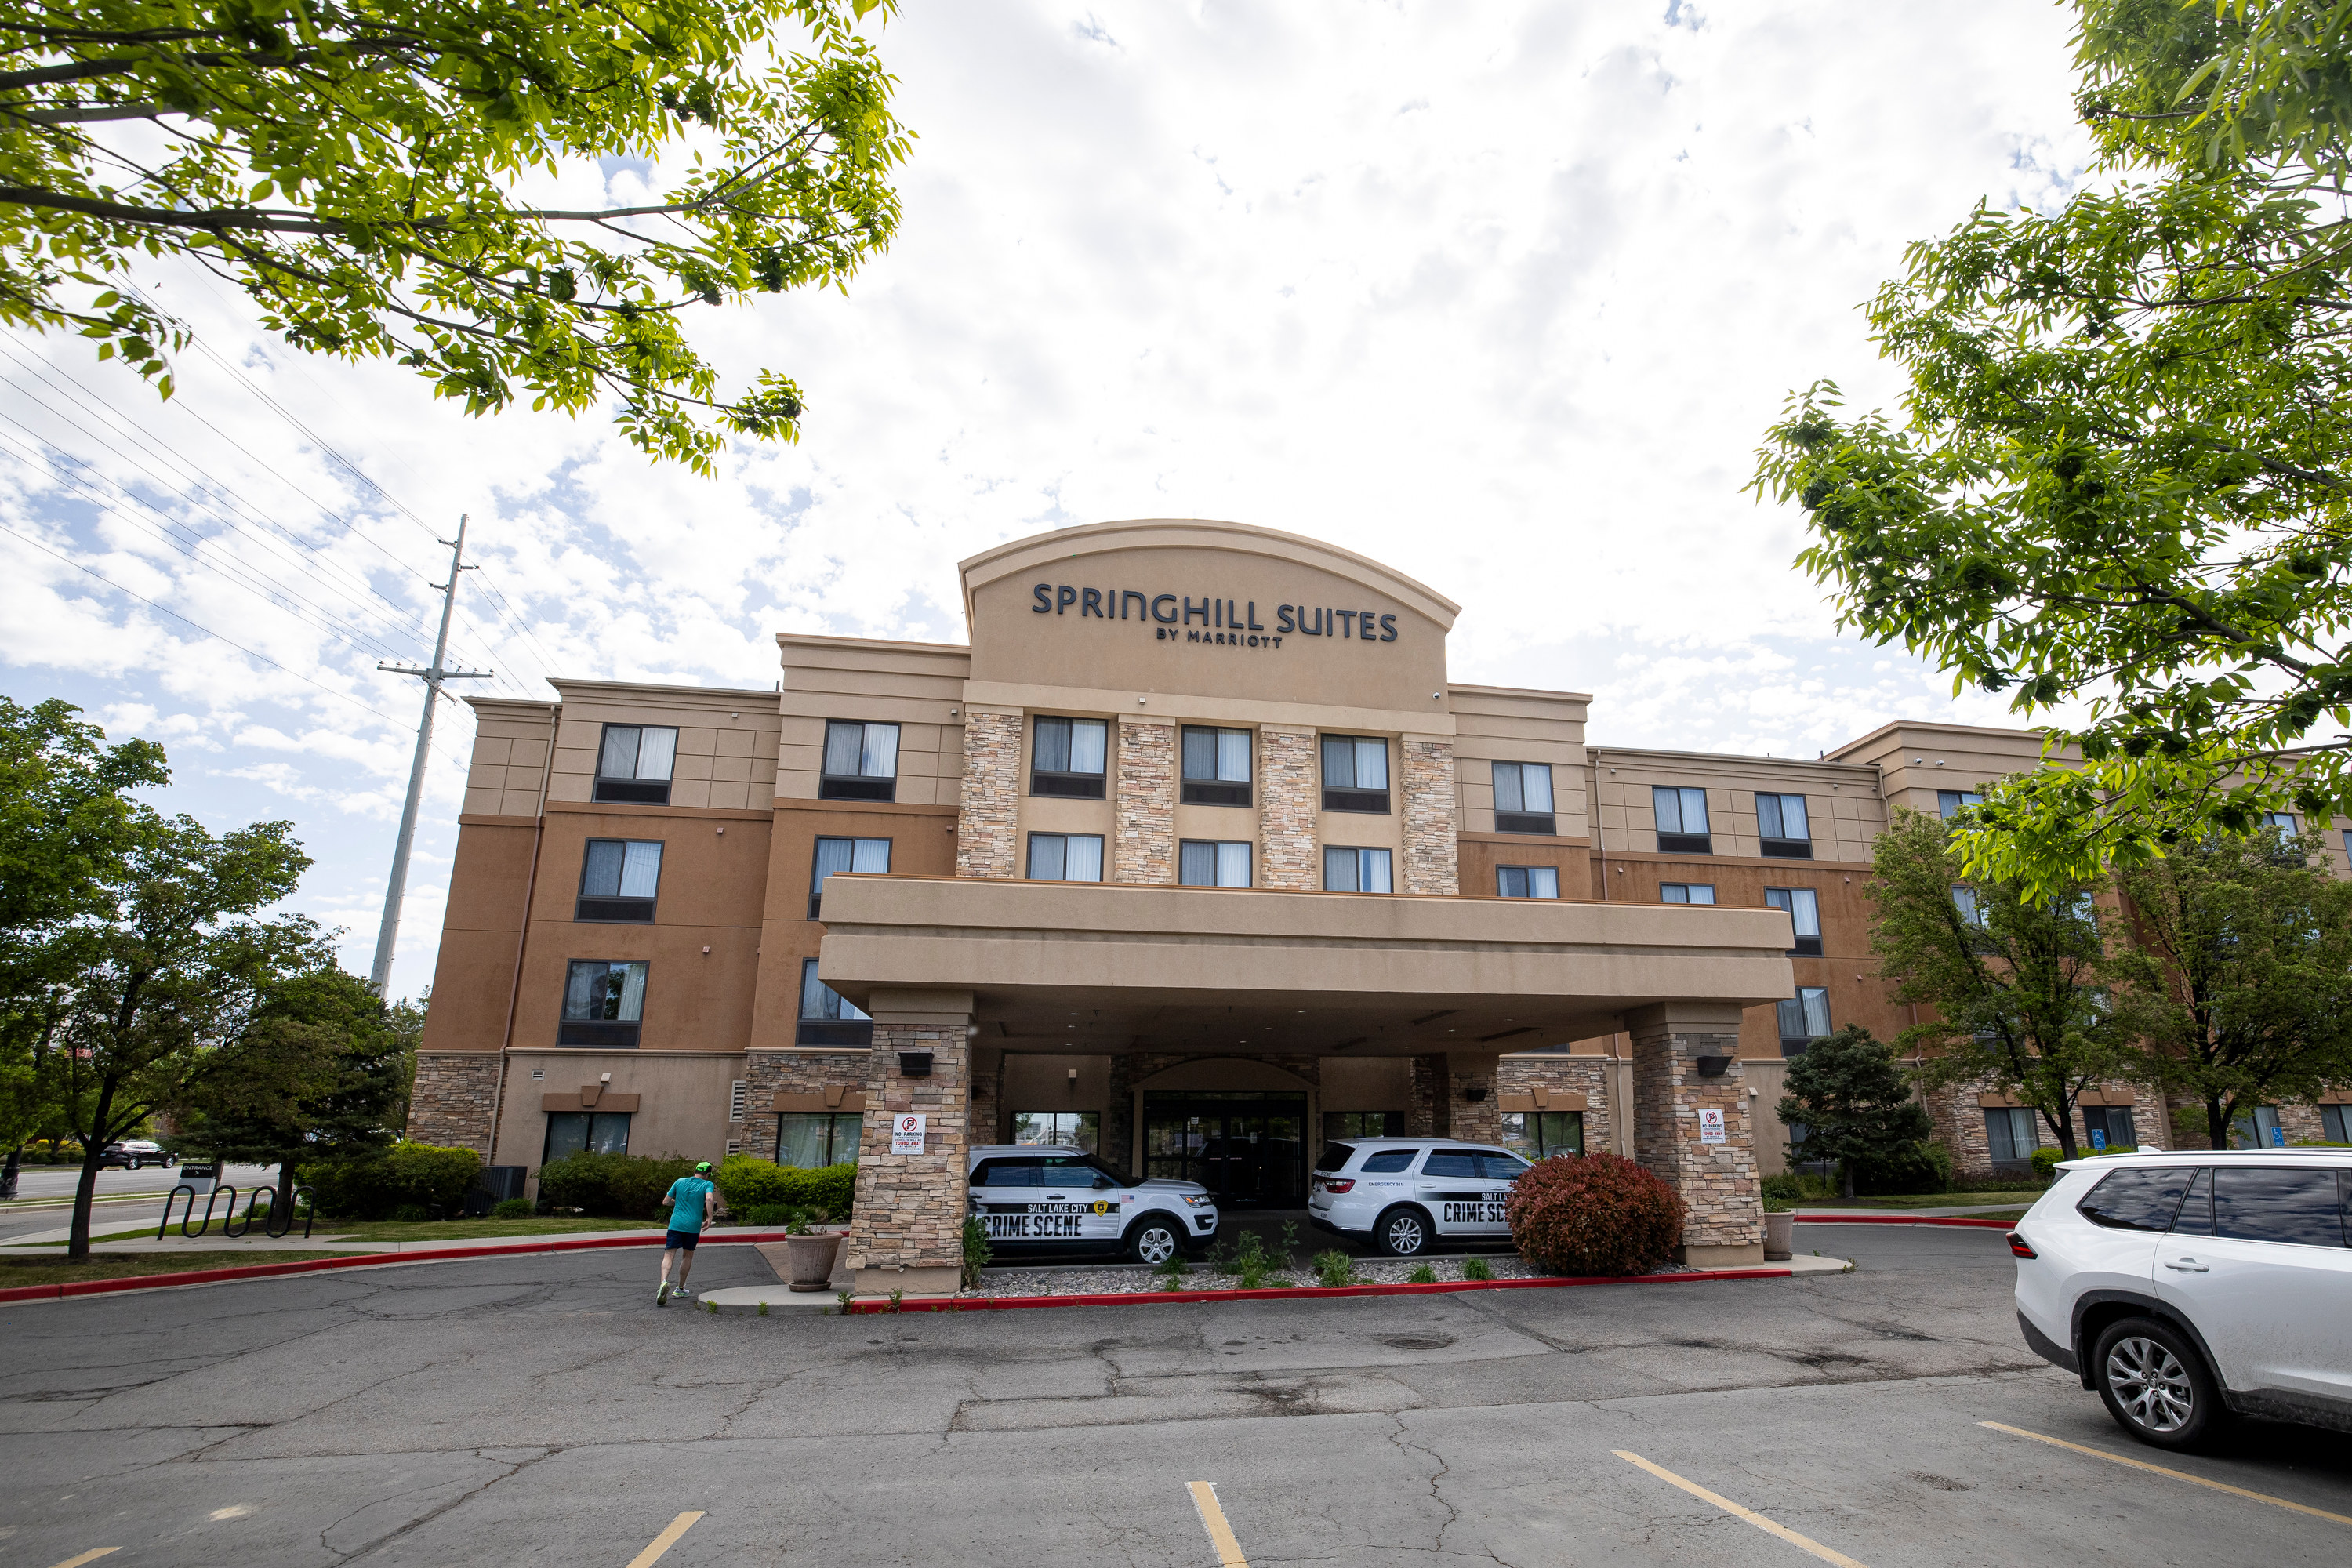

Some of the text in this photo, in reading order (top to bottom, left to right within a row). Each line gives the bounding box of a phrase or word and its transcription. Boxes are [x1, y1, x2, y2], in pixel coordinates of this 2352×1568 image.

[1032, 583, 1398, 642] SPRINGHILL SUITES
[1156, 627, 1283, 649] BY MARRIOTT
[1481, 1192, 1497, 1201] SALT
[1028, 1203, 1047, 1213] SALT
[1048, 1203, 1070, 1213] LAKE
[1071, 1203, 1088, 1213] CITY
[1444, 1203, 1484, 1223] CRIME
[983, 1215, 1083, 1237] CRIME SCENE
